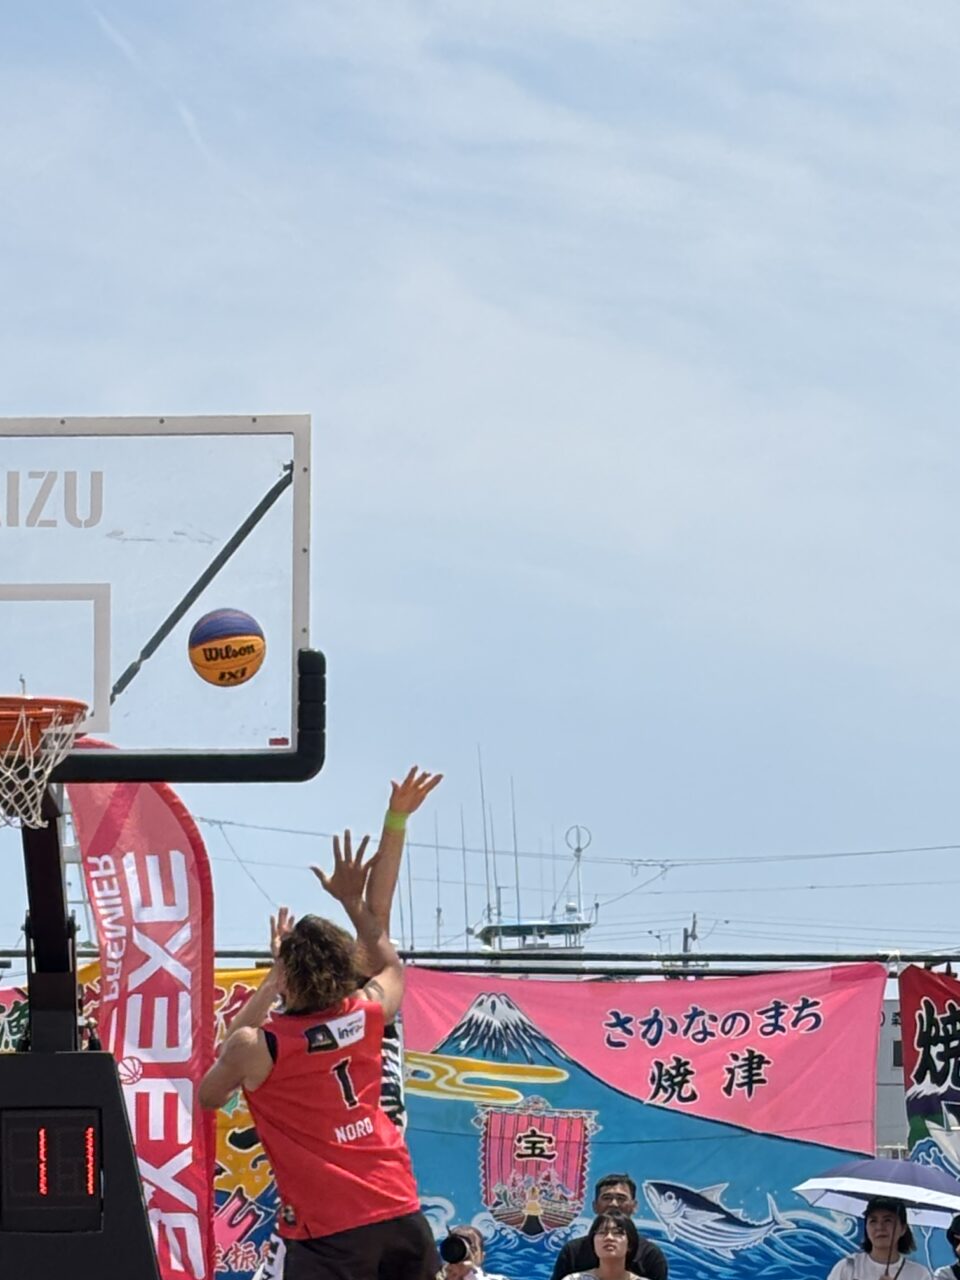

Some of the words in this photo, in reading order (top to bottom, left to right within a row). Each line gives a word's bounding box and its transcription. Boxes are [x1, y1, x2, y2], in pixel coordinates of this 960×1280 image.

[202, 644, 256, 662] Wilson
[603, 996, 823, 1049] さかなのまち
[329, 1056, 359, 1110] 1
[38, 1126, 95, 1196] 11
[514, 1128, 557, 1162] 宝
